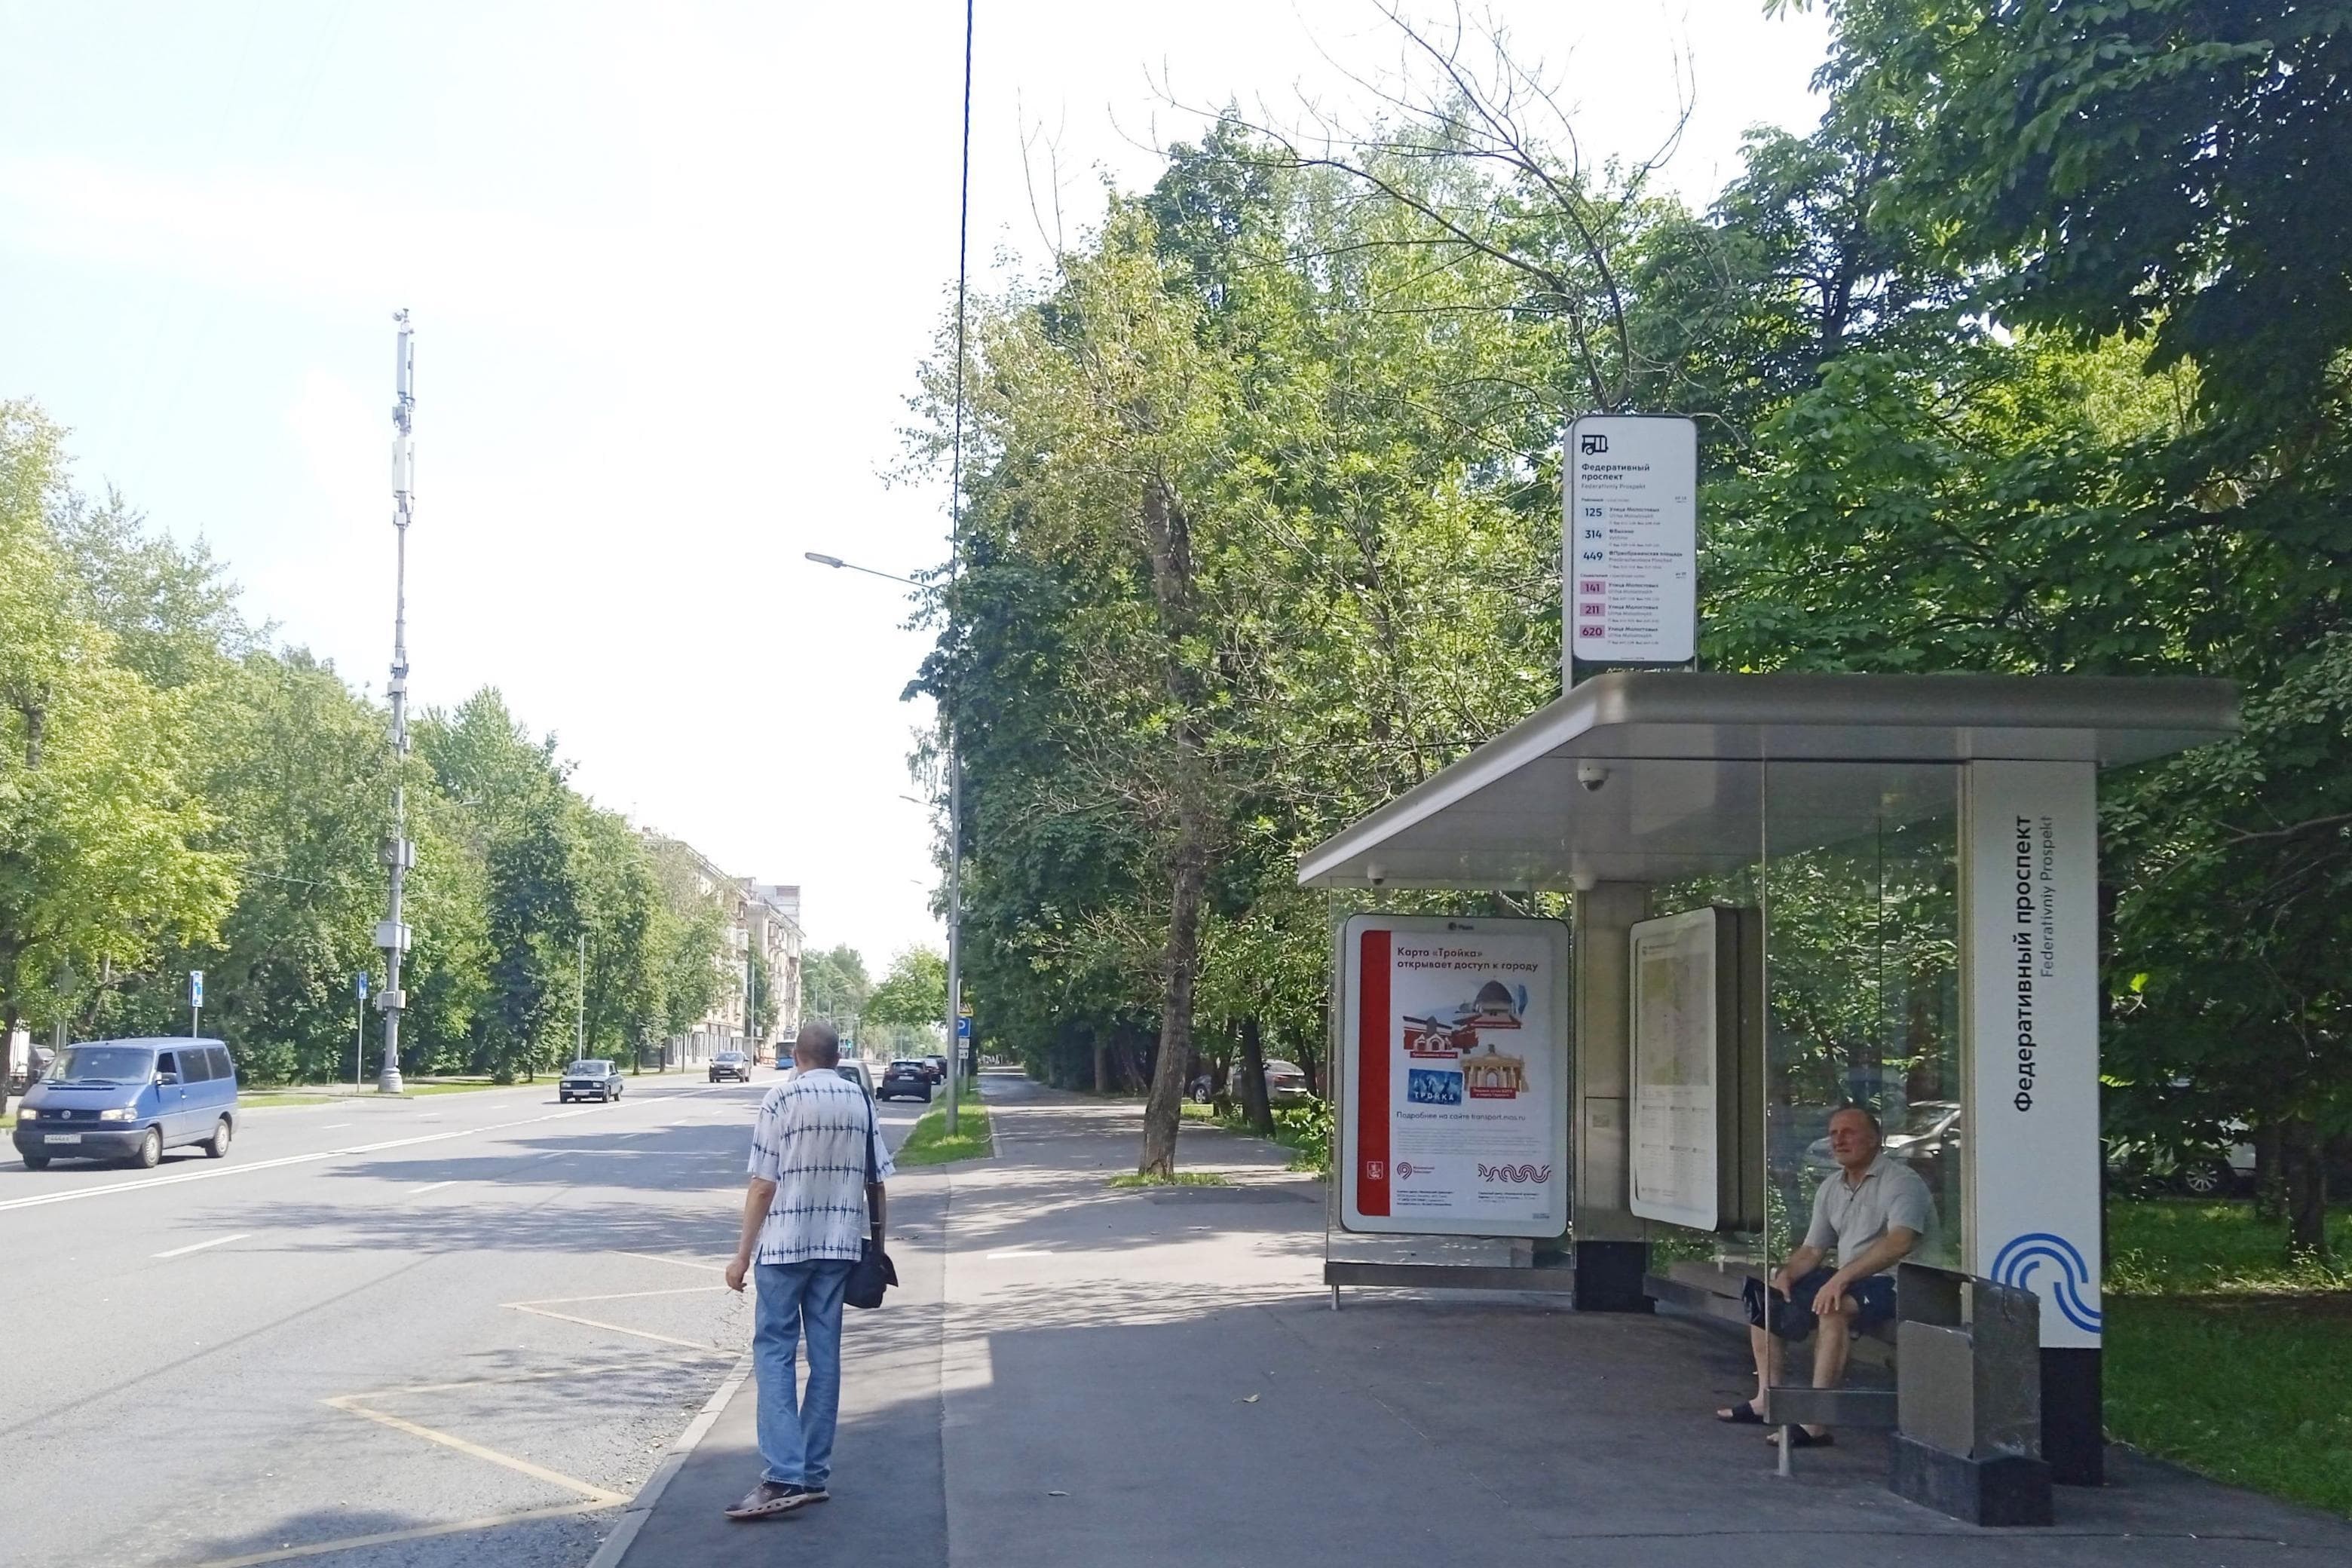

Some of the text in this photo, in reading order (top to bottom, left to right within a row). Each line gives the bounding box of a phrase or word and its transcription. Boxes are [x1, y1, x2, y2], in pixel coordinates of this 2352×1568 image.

[1582, 463, 1650, 472] Федеративный
[1585, 507, 1603, 517] 125
[1585, 529, 1602, 539] 314
[1583, 552, 1603, 561] 449
[1585, 583, 1600, 593] 141
[1585, 605, 1600, 614] 211
[1582, 627, 1603, 636] 620
[2039, 816, 2056, 978] Federativniy Prospekt
[1397, 947, 1483, 959] Карта «Тройка»
[1397, 961, 1452, 970] открывает
[1453, 962, 1490, 972] доступ
[1501, 963, 1539, 972] городу
[2012, 814, 2036, 1112] Федеративный проспект
[1396, 1111, 1438, 1120] Подробнее
